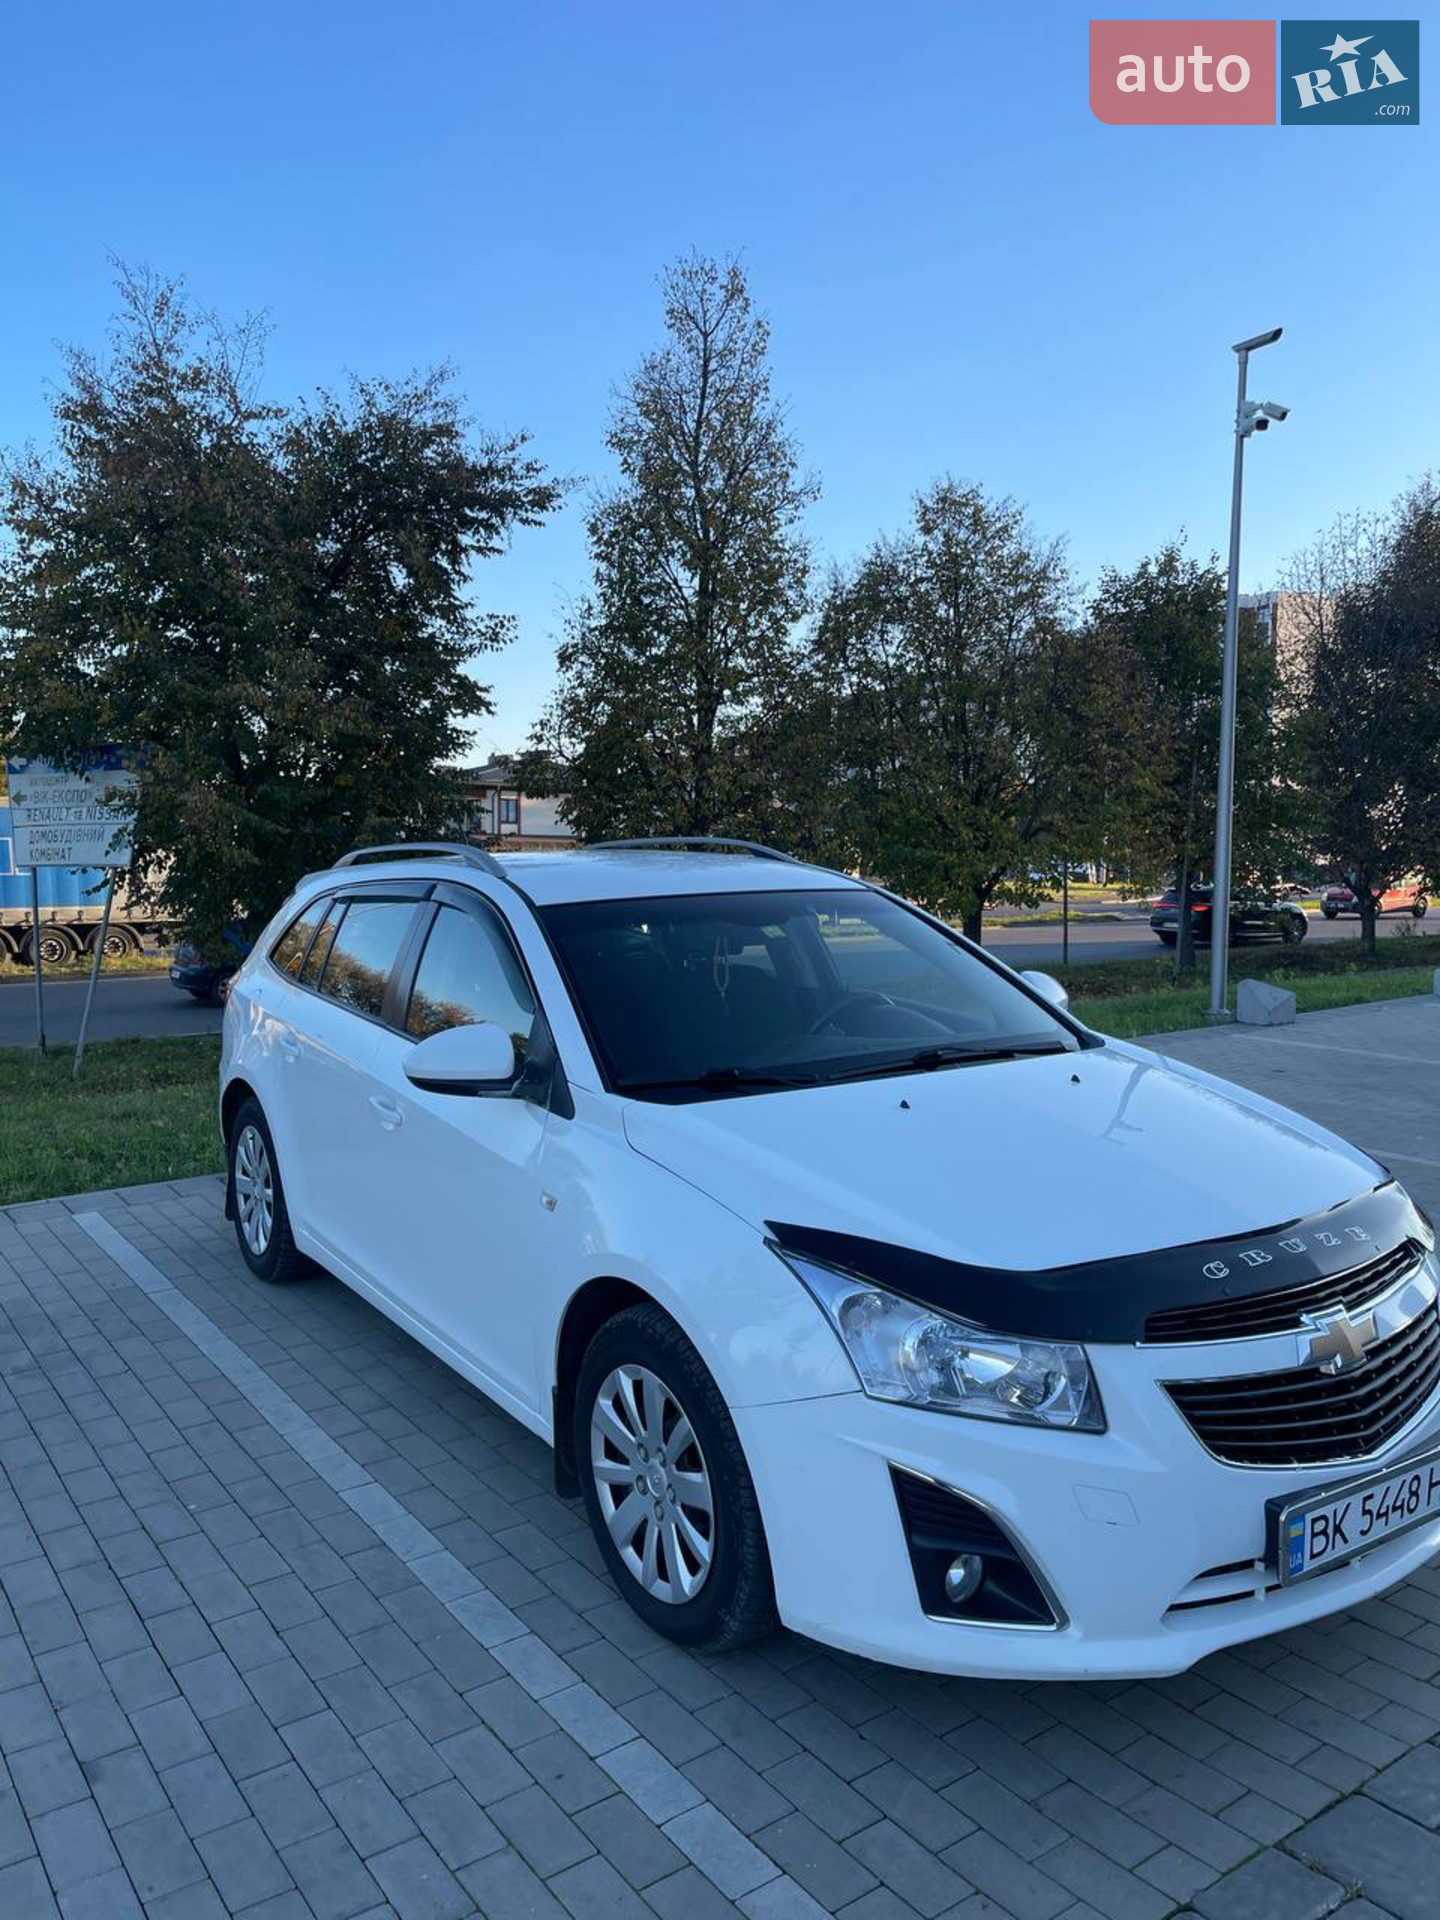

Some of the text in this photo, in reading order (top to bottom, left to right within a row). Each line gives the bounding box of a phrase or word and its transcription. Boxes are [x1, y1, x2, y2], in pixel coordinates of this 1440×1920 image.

[26, 807, 71, 822] RENAULT
[29, 826, 105, 845] ДОМОБУДІВНИЙ
[29, 847, 73, 862] КОМБІНАТ
[1202, 1226, 1371, 1279] CRUZE
[1309, 1502, 1351, 1561] BK
[1359, 1473, 1421, 1536] 5448
[1289, 1552, 1303, 1568] UA
